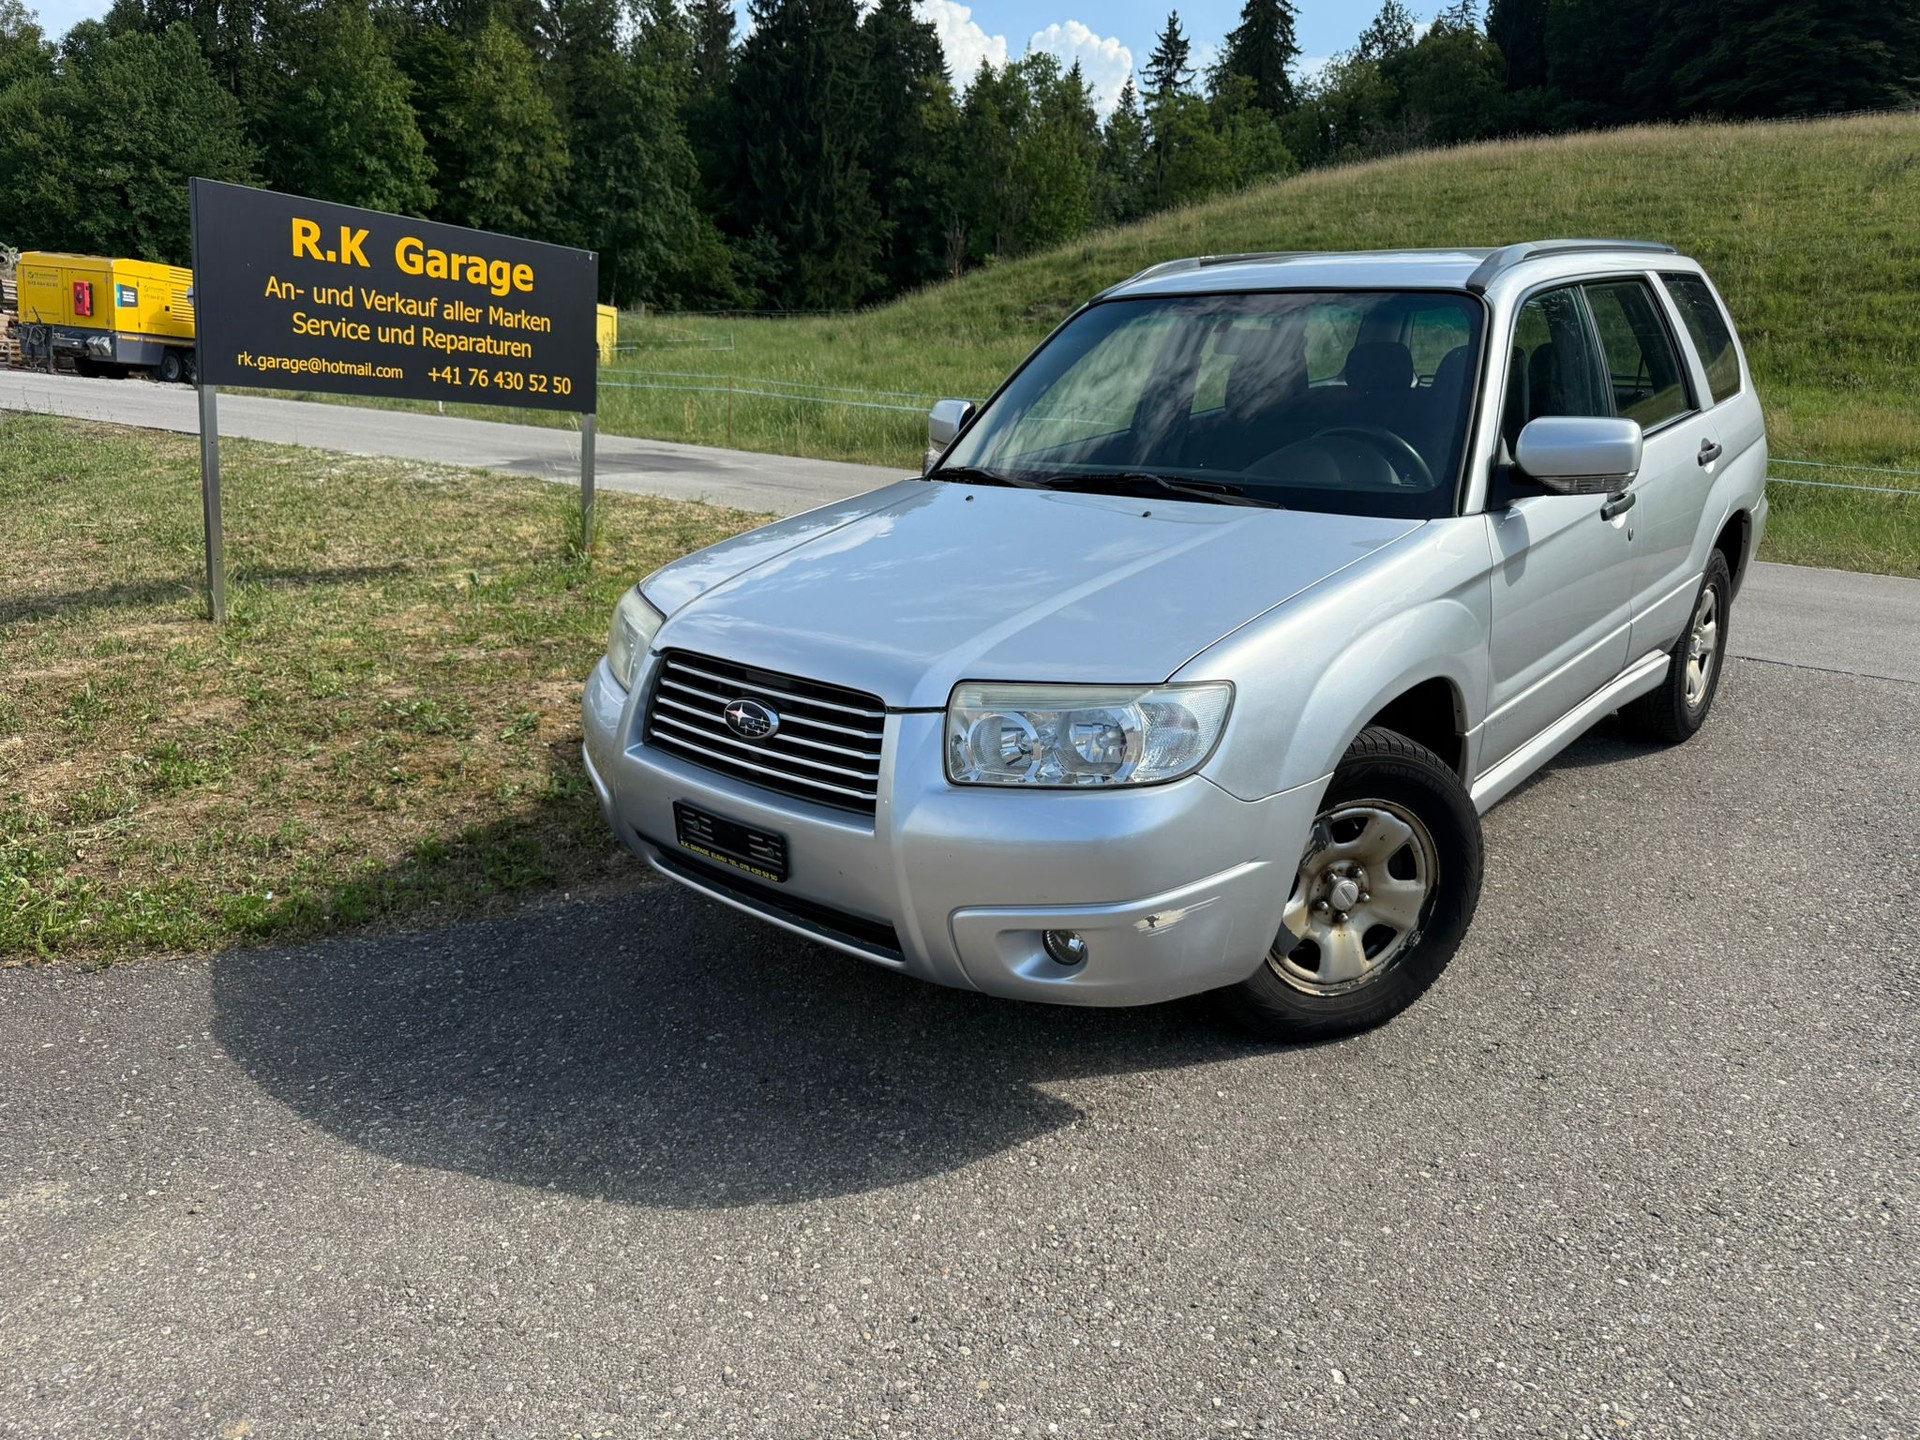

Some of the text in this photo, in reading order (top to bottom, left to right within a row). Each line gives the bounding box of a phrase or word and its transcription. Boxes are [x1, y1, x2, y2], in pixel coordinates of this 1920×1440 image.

[291, 217, 535, 298] R.K Garage
[265, 275, 551, 333] An- und Verkauf aller Marken
[292, 312, 532, 358] Service und Reparaturen
[238, 351, 572, 395] rk.garage@hotmail.com +41 76 430 52 50
[690, 843, 710, 856] GARAGE
